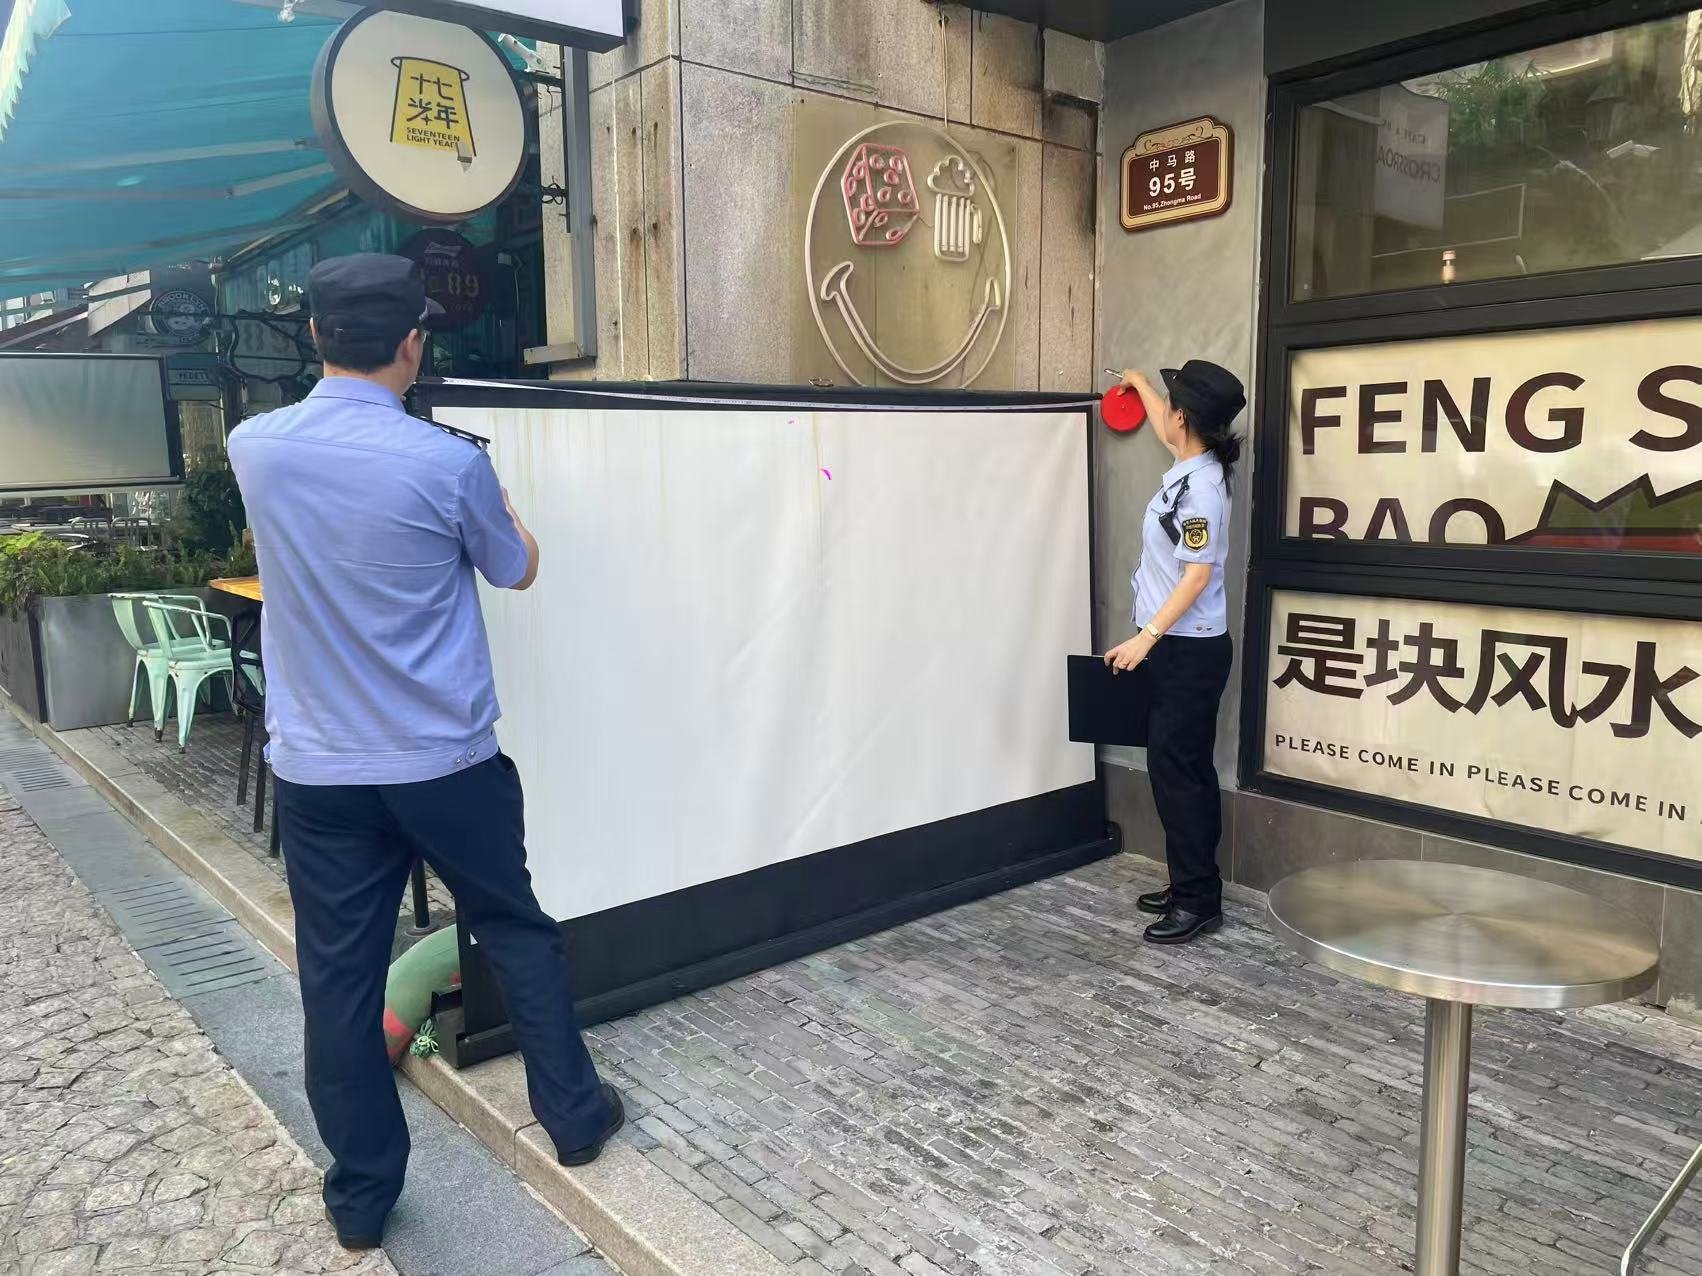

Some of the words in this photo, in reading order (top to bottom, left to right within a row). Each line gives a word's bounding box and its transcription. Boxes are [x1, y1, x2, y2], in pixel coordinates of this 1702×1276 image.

[410, 73, 454, 101] 十七
[406, 127, 460, 142] SEVENTEEN
[406, 133, 431, 144] LIGHT
[1149, 150, 1196, 172] 中马路
[1149, 167, 1196, 197] 95号
[1186, 193, 1202, 201] Road
[1300, 371, 1586, 456] FENG
[1272, 611, 1702, 740] 是块风水
[1275, 733, 1349, 760] PLEASE
[1358, 748, 1419, 773] COME
[1429, 760, 1455, 778] IN
[1466, 764, 1561, 797] PLEASE
[1568, 784, 1648, 813] COME
[1658, 799, 1686, 821] IN
